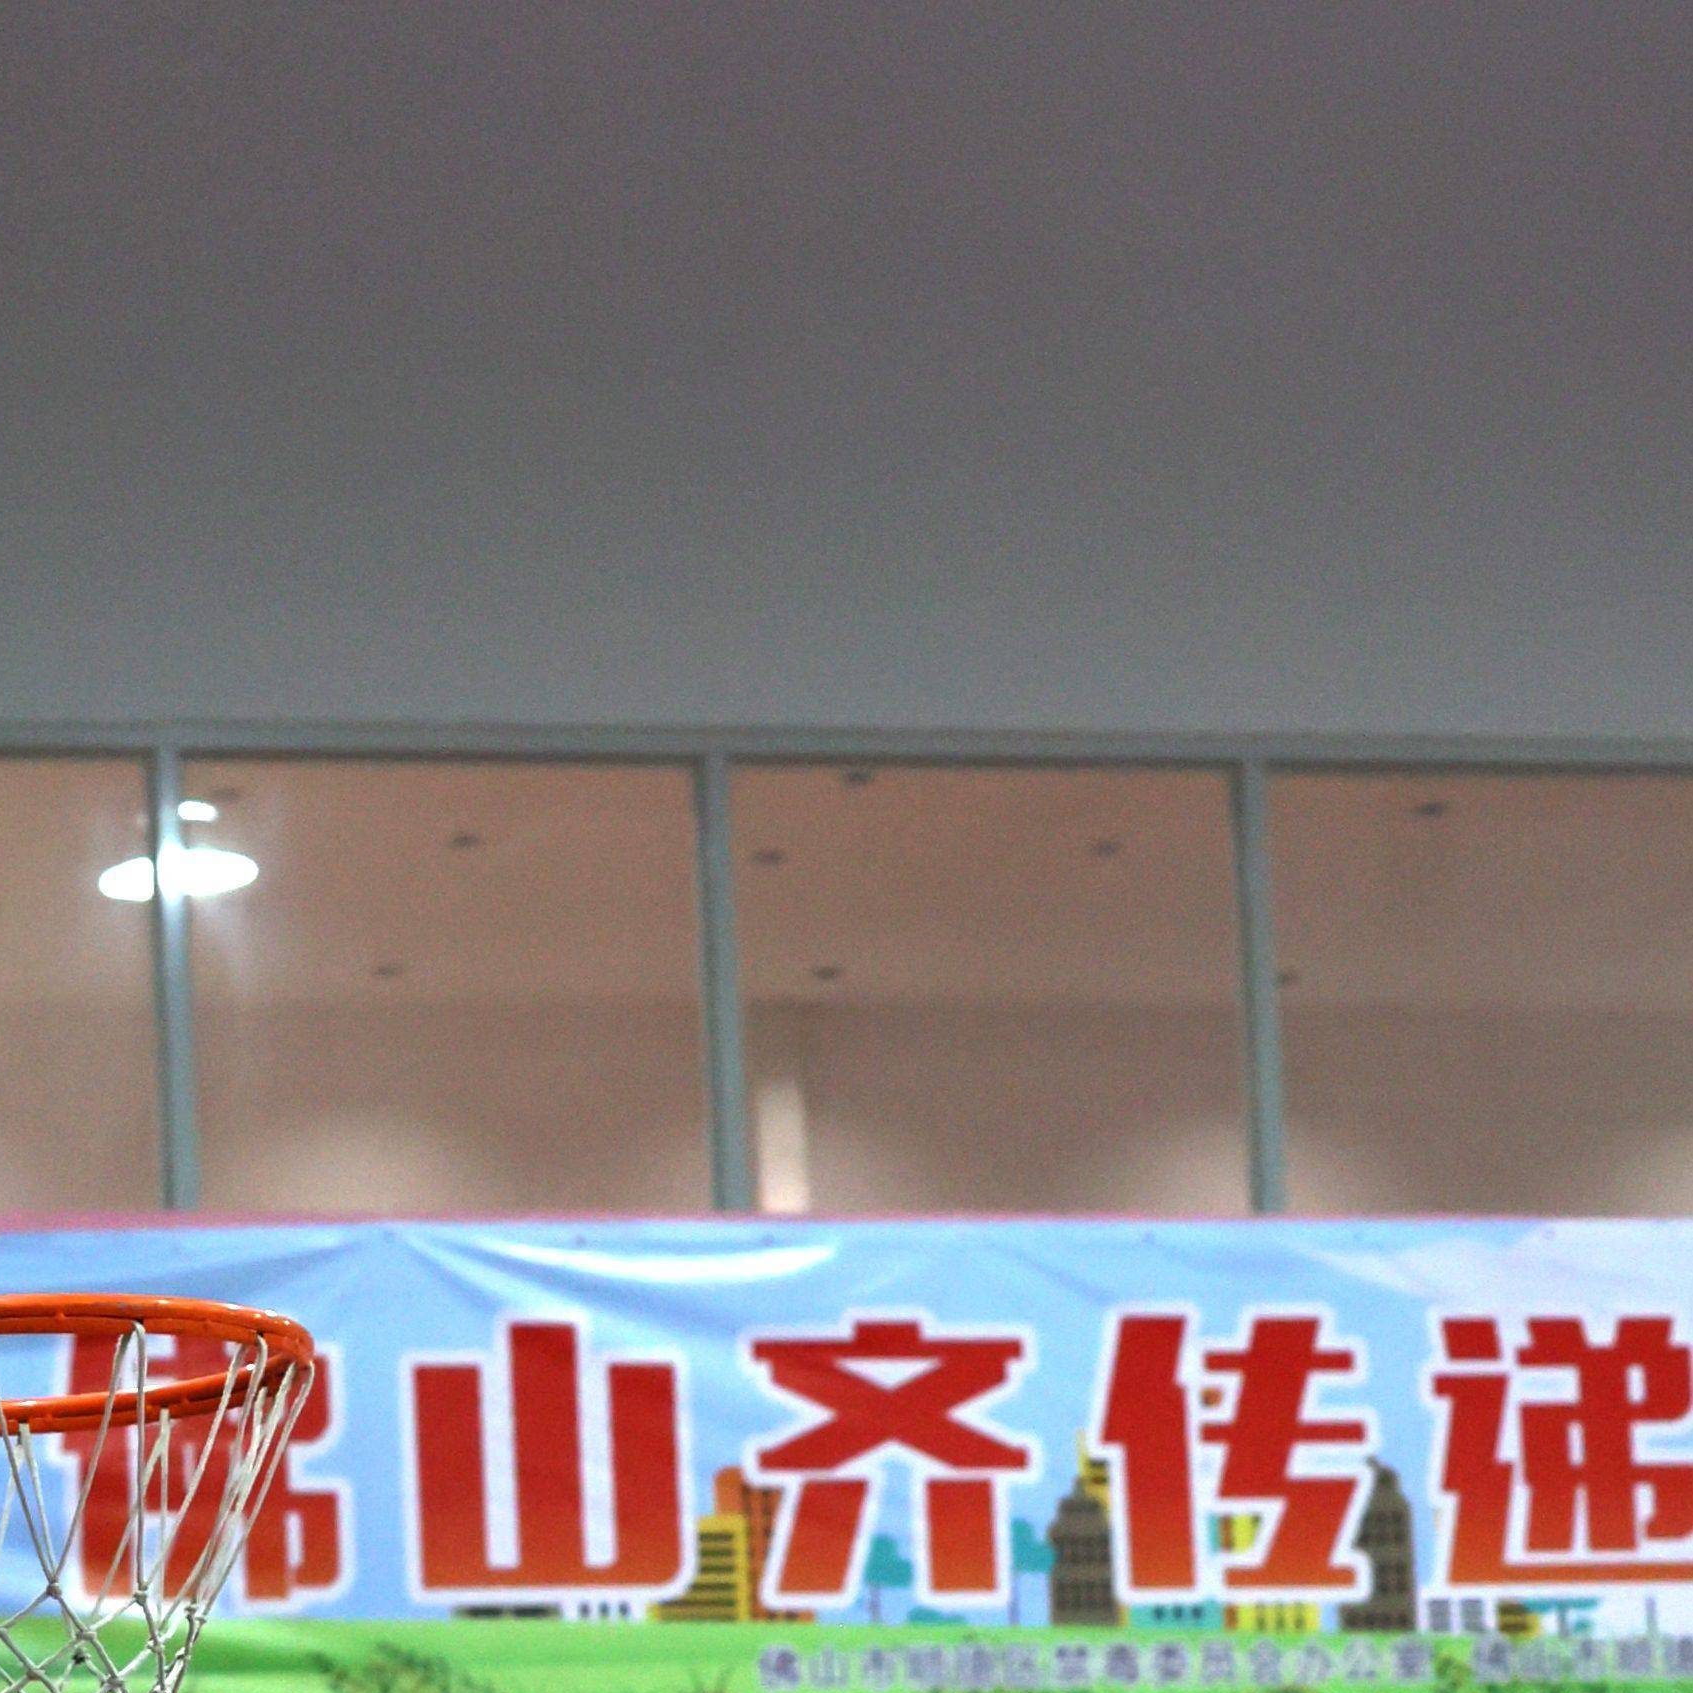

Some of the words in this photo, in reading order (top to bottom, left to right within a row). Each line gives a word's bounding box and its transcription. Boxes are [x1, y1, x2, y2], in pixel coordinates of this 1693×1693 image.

[63, 1312, 1693, 1604] 佛山齐传递
